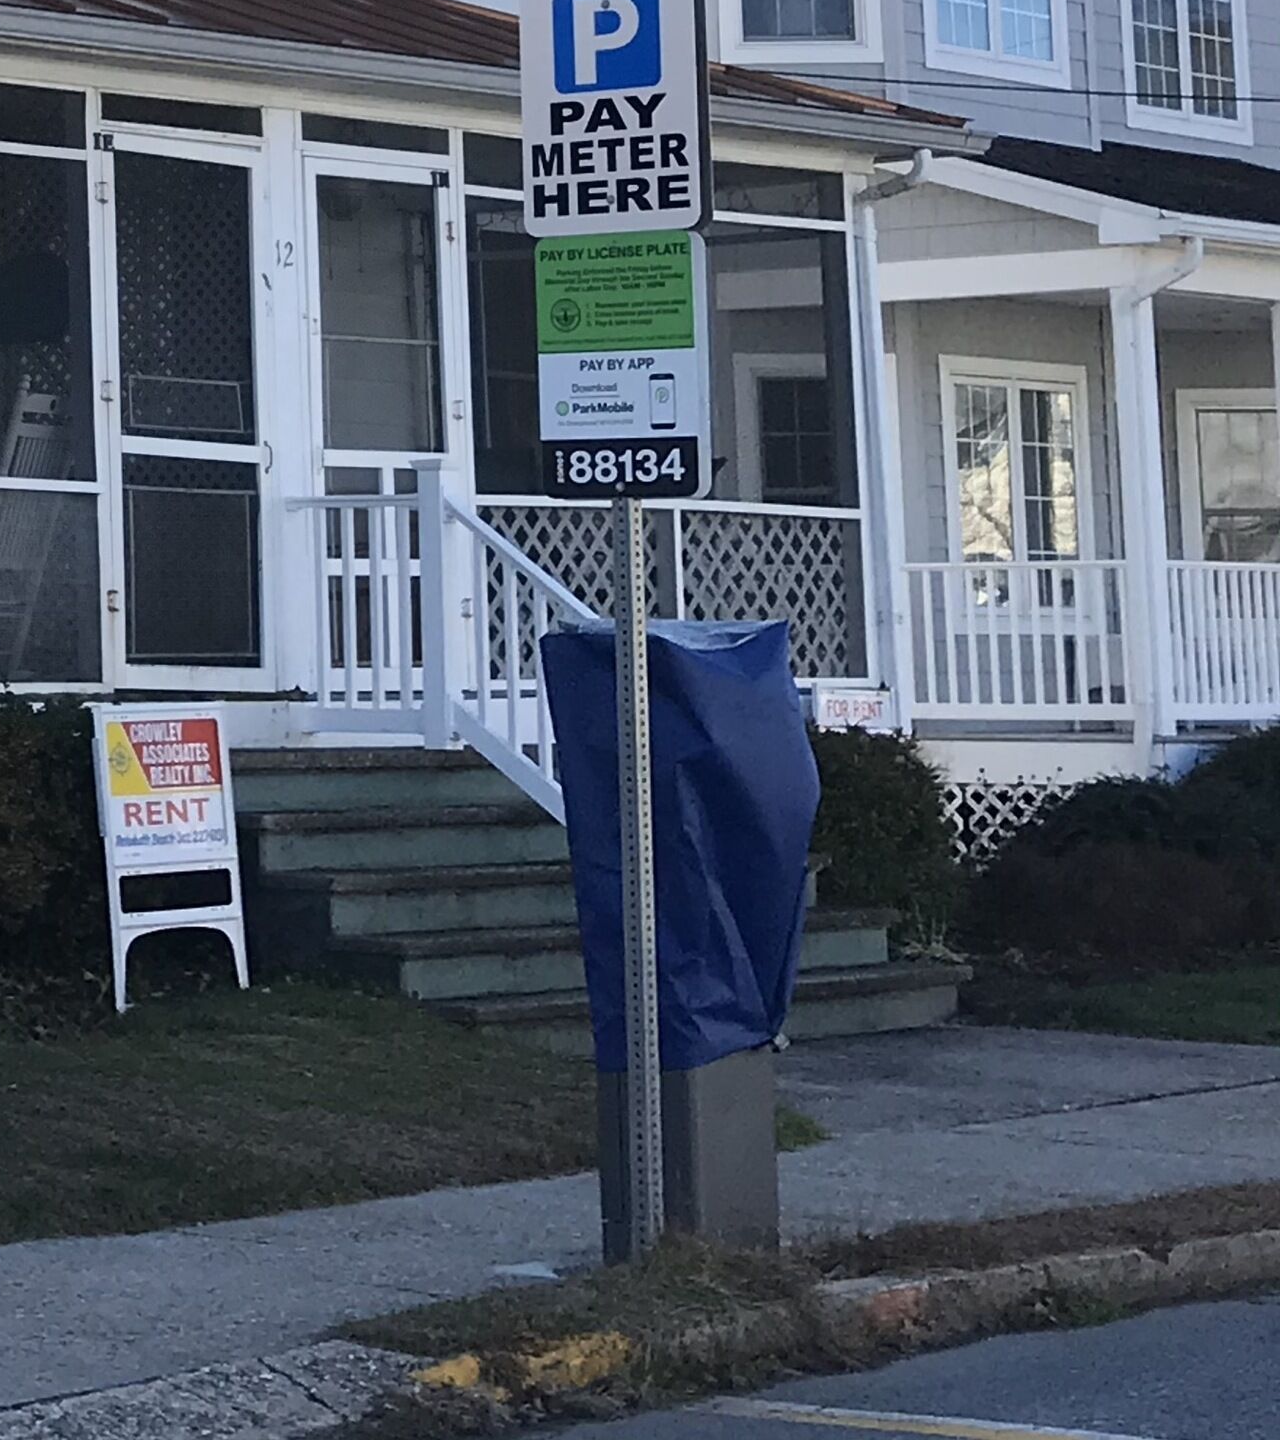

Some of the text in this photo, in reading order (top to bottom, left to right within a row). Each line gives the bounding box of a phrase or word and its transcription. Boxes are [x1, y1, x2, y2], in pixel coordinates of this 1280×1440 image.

[549, 92, 667, 136] PAY
[531, 133, 689, 178] METER
[533, 174, 691, 218] HERE
[275, 239, 294, 269] 12
[540, 242, 688, 262] PAY BY LICENSE PLATE
[579, 357, 655, 372] PAY BY APP
[571, 382, 618, 393] Download
[572, 402, 635, 414] ParkMobile
[569, 447, 686, 484] 88134
[826, 699, 884, 719] FOR RENT
[142, 742, 210, 764] ASSOCIATES
[123, 797, 210, 828] RENT
